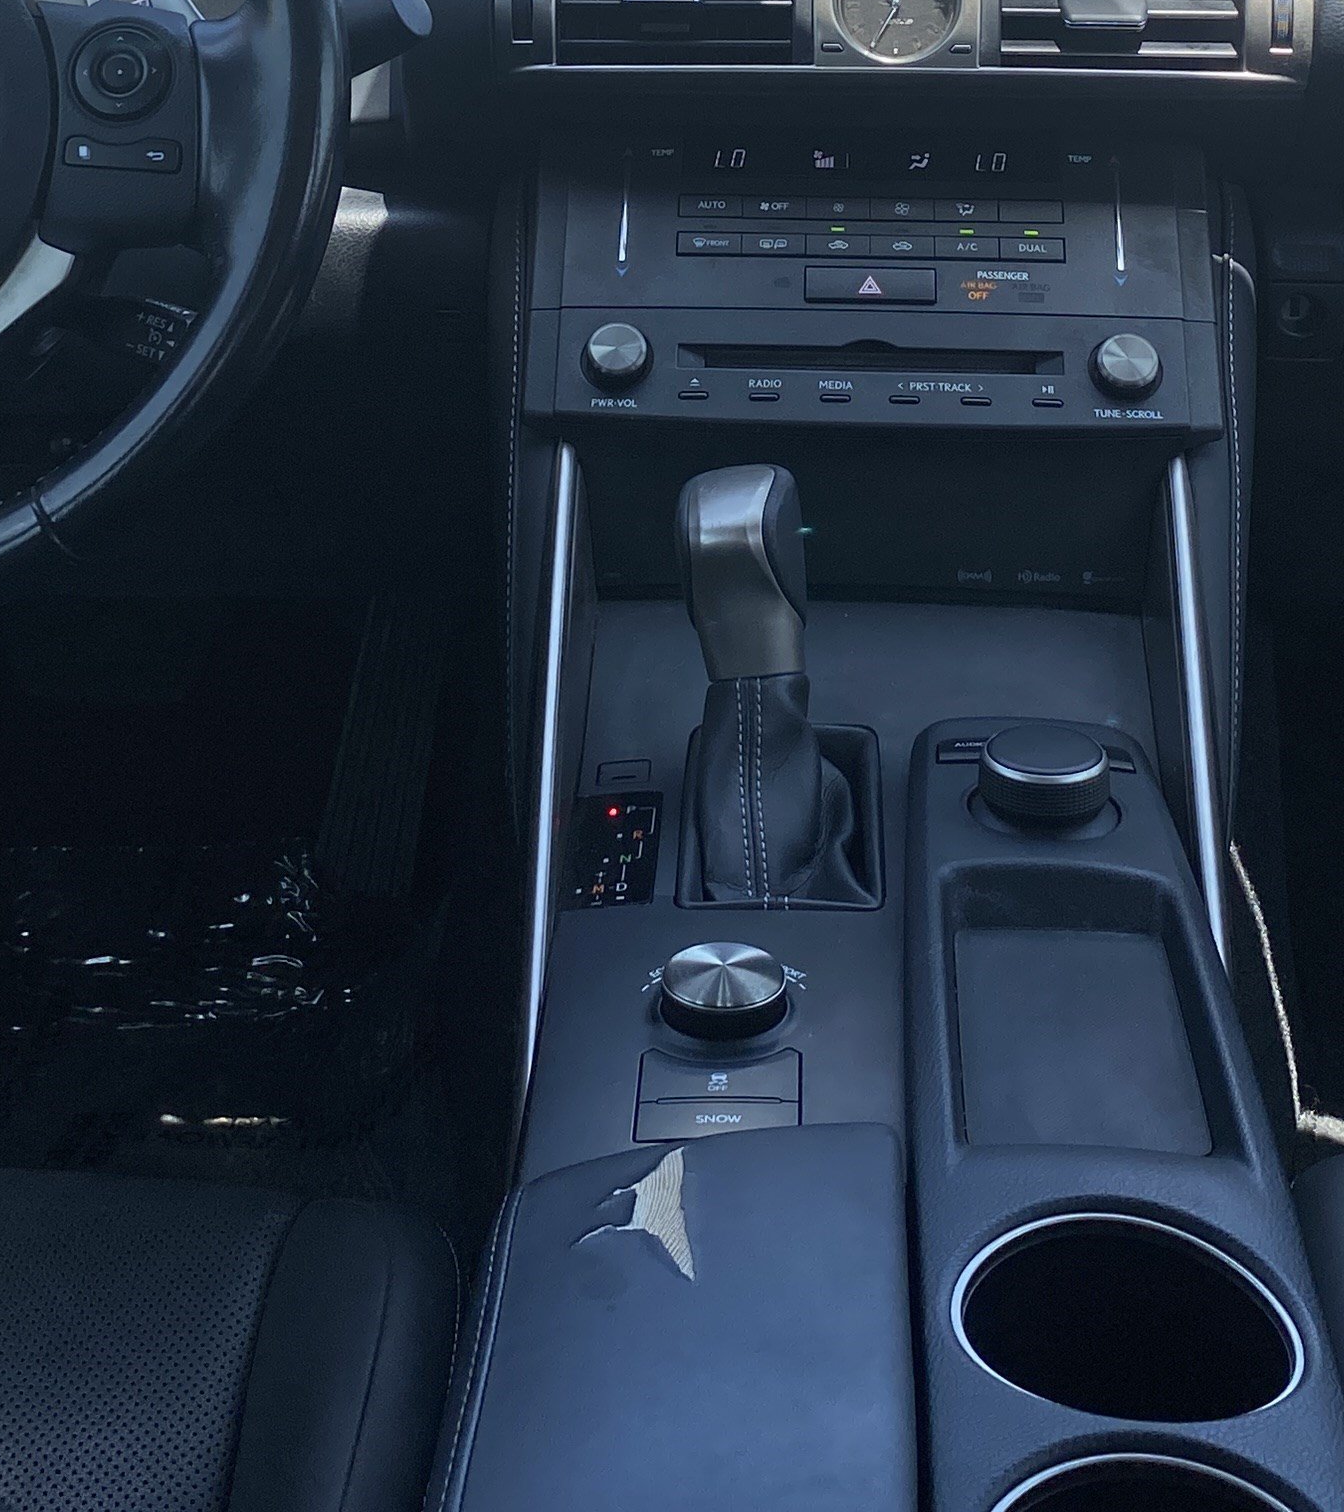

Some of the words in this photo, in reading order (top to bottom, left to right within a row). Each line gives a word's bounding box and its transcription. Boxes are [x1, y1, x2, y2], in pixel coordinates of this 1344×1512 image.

[651, 148, 675, 157] TEMP
[1067, 154, 1092, 164] TEMP
[697, 200, 726, 210] AUTO
[770, 201, 789, 211] OFF
[706, 239, 730, 248] FRONT
[956, 242, 978, 252] A/C
[1018, 243, 1047, 253] DUAL
[977, 270, 1029, 281] PASSENGER
[967, 291, 990, 301] OFF
[748, 379, 782, 388] RADIO
[819, 380, 854, 390] MEDIA
[633, 829, 644, 840] R
[619, 854, 632, 864] N
[616, 882, 628, 892] D
[707, 1084, 729, 1092] OFF
[695, 1114, 742, 1124] SNOW
